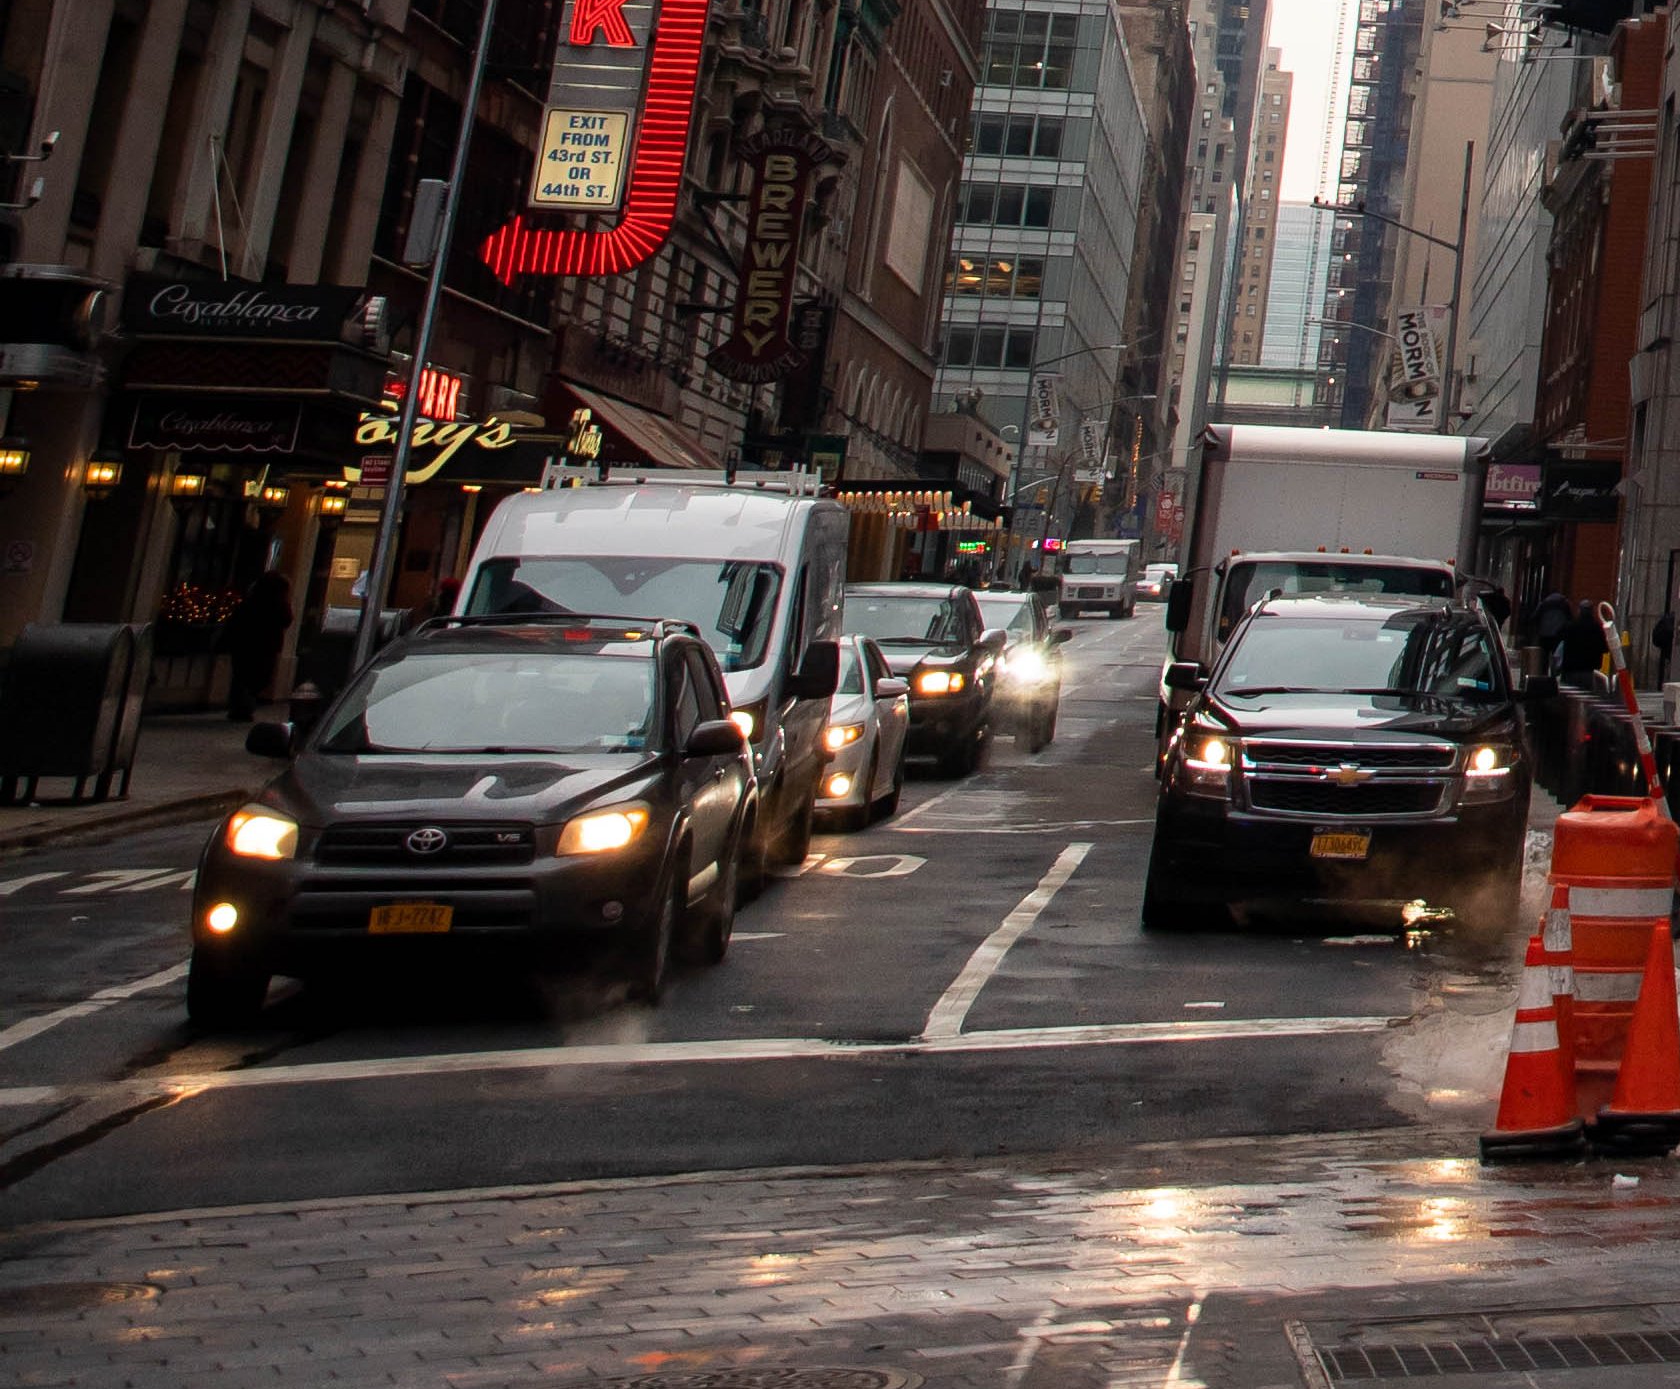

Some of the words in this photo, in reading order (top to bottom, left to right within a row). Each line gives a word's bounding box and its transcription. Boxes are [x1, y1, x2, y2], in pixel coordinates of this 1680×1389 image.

[569, 116, 608, 130] EXIT
[561, 132, 610, 149] FROM
[548, 149, 585, 165] 43rd
[587, 149, 615, 165] ST.
[568, 166, 591, 181] OR
[542, 183, 579, 199] 44th
[582, 185, 609, 200] ST.
[741, 153, 800, 358] BREWERY
[149, 282, 321, 324] Casablanca
